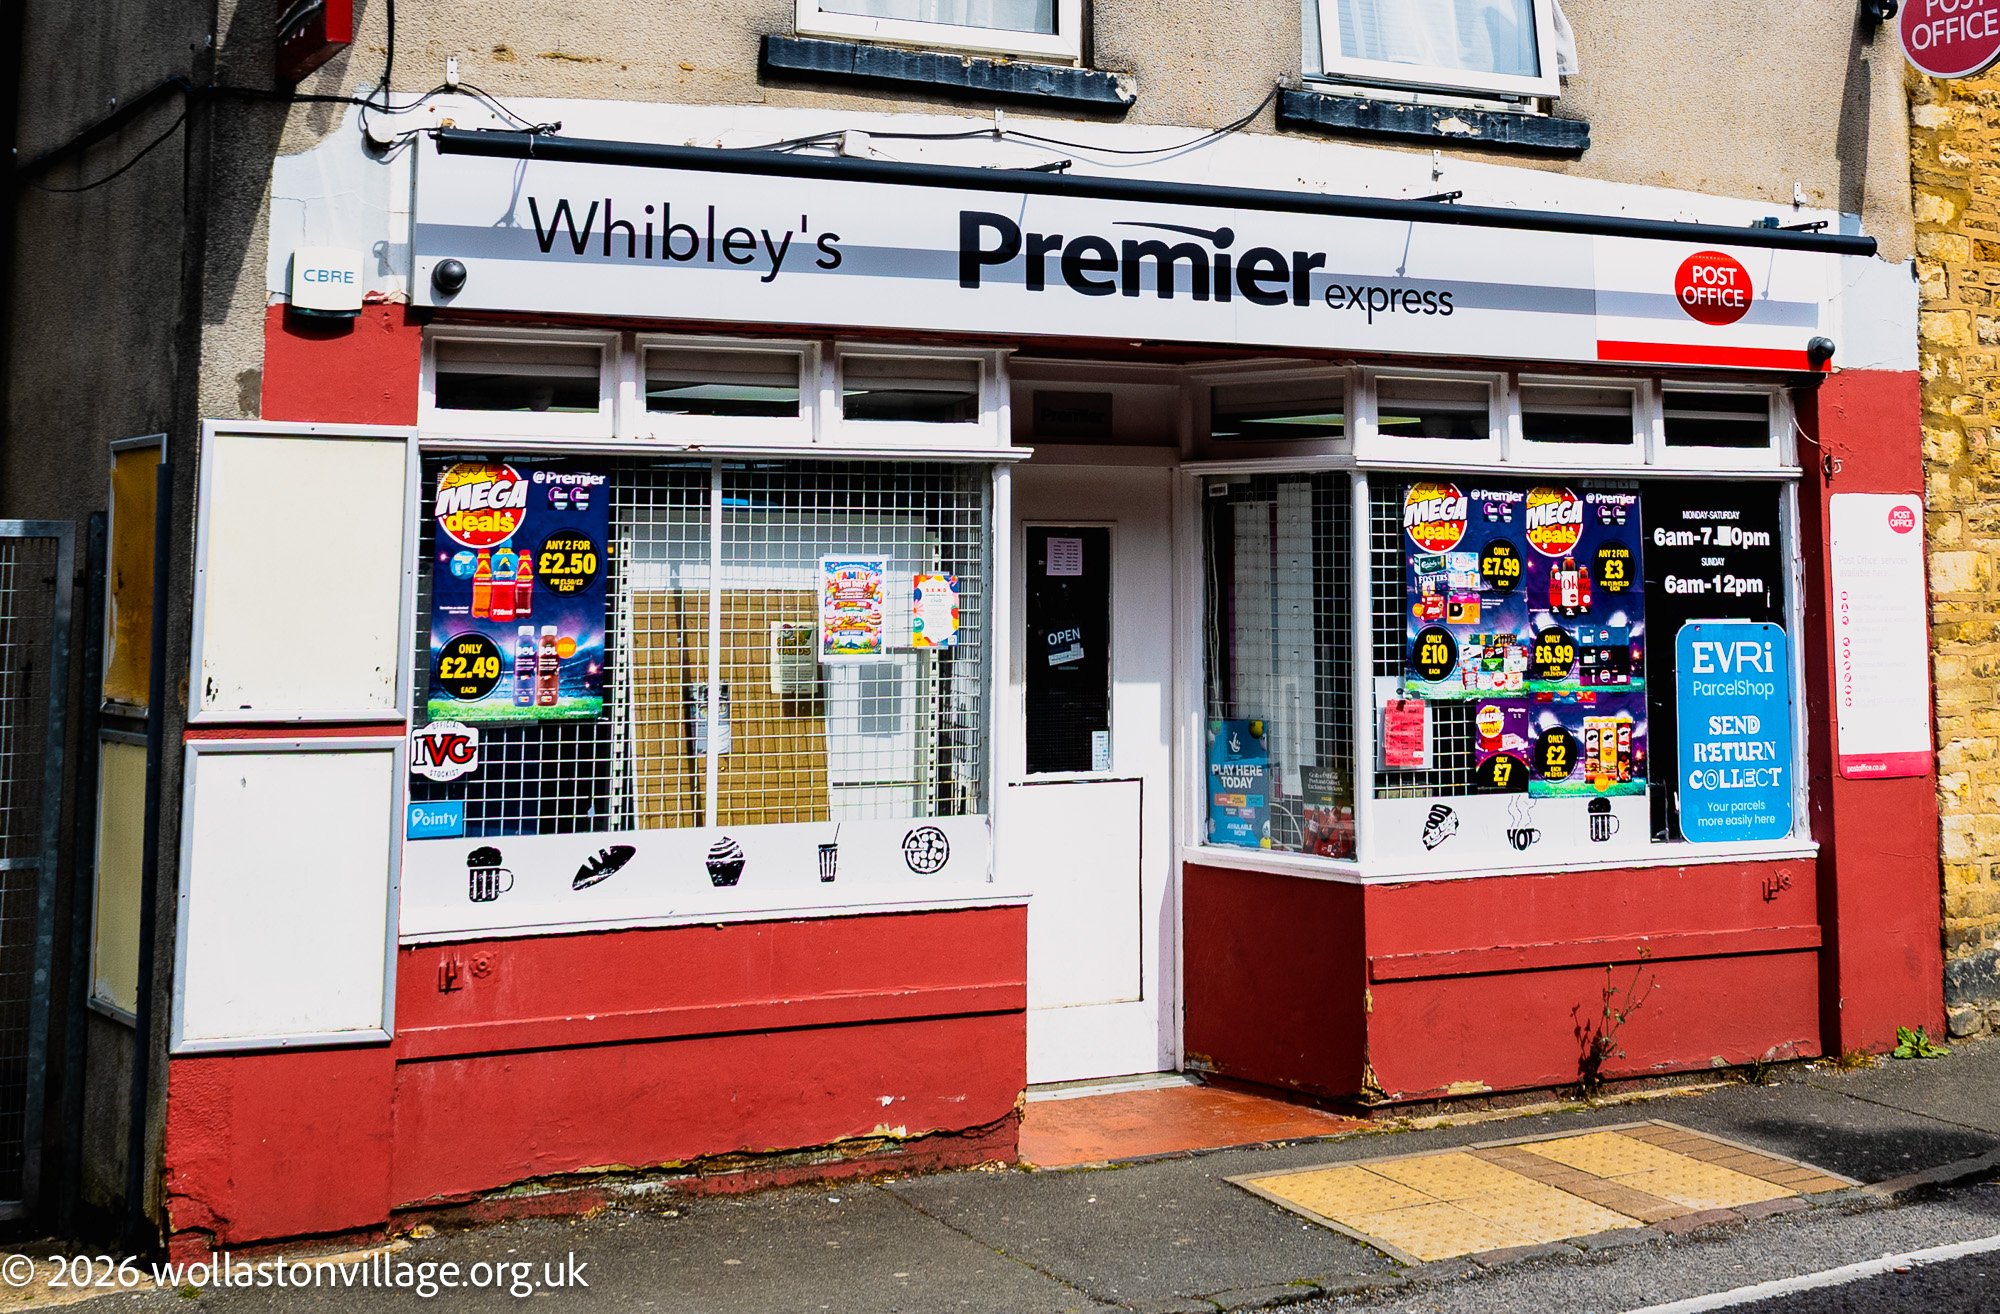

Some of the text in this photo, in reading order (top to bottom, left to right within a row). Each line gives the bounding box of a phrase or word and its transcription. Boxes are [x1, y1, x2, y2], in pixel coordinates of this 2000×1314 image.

[1911, 8, 1999, 50] OFFICE
[528, 196, 843, 283] Whibley's
[303, 268, 355, 285] CBRE
[958, 210, 1454, 325] Premier express
[1692, 265, 1738, 287] POST
[1682, 286, 1745, 308] OFFICE
[435, 480, 529, 517] MEGA
[1471, 489, 1524, 502] @Premier
[1586, 493, 1637, 504] @Premier
[446, 511, 515, 532] deals
[1404, 496, 1468, 528] MEGA
[1526, 500, 1584, 530] MEGA
[1682, 510, 1740, 520] MONDAY-SATURDAY
[1893, 510, 1911, 519] POST
[1412, 522, 1460, 540] deals
[1889, 518, 1914, 528] OFFICE
[1530, 526, 1577, 544] deals
[1653, 525, 1770, 550] 6am-7.0pm
[545, 540, 591, 550] ANY 2 FOR
[1493, 546, 1510, 555] ONLY
[1598, 550, 1611, 558] ANY
[1617, 550, 1629, 558] FOR
[539, 552, 597, 575] £2.50
[1482, 557, 1520, 577] £7.99
[1605, 559, 1624, 579] £3
[1701, 557, 1725, 566] SUNDAY
[836, 571, 870, 580] FAMILY
[1664, 574, 1763, 597] 6am-12pm
[1048, 627, 1081, 646] OPEN
[1426, 634, 1443, 643] ONLY
[1544, 634, 1561, 643] ONLY
[459, 644, 482, 655] ONLY
[1421, 644, 1448, 664] £10
[1535, 645, 1574, 664] £6.99
[1692, 641, 1774, 674] EVRi
[440, 657, 500, 679] £2.49
[461, 686, 477, 694] EACH
[1693, 679, 1774, 700] ParcelShop
[1708, 714, 1760, 736] SEND
[1548, 735, 1564, 743] ONLY
[413, 733, 477, 767] IVG
[1546, 745, 1566, 766] £2
[1693, 740, 1776, 763] RETURN
[430, 768, 459, 778] STOCKIST
[1211, 764, 1263, 777] PLAY HERE
[1493, 763, 1512, 782] £7
[1846, 763, 1887, 774] postoffice.co.uk
[1221, 777, 1254, 789] TODAY
[1688, 766, 1782, 791] COLLECT
[1707, 800, 1766, 814] Your parcels
[412, 808, 458, 828] Pointy
[1698, 814, 1775, 829] more easily here
[1507, 828, 1534, 851] HOT
